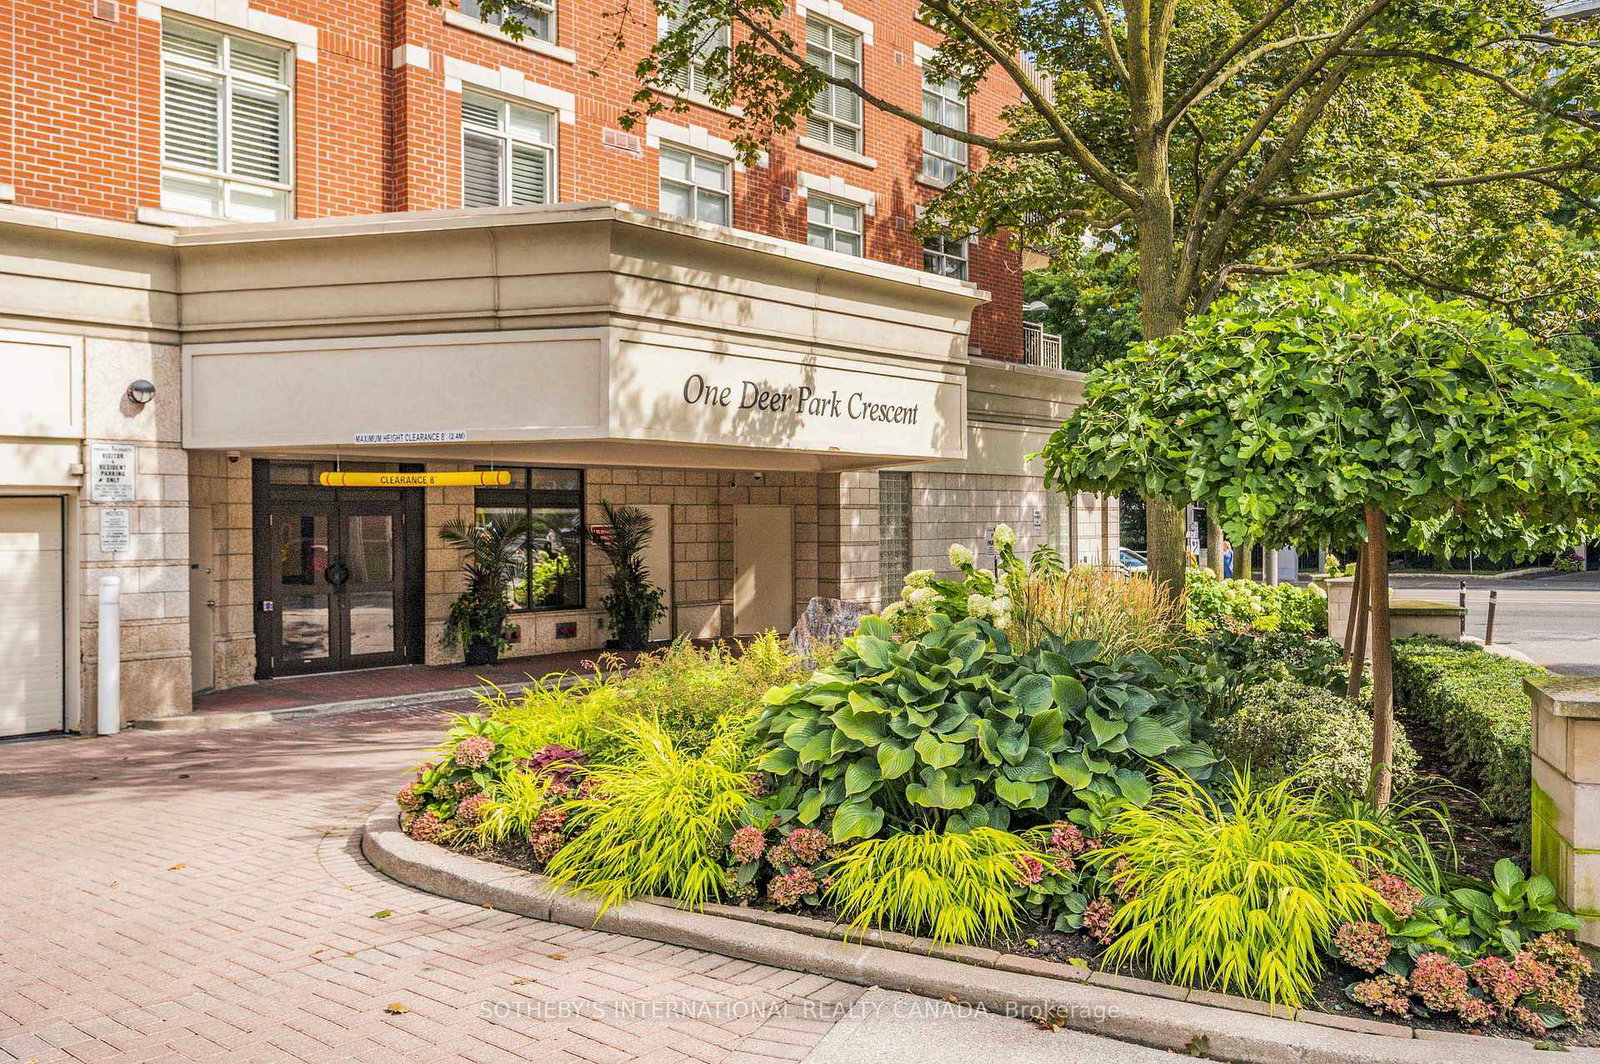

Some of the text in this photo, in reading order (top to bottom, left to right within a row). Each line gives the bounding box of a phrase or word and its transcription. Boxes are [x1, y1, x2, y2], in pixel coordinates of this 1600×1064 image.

[683, 374, 919, 425] One Deer Park Crescent
[355, 434, 382, 443] MAXIMUM
[383, 433, 403, 442] HEIGHT
[404, 432, 439, 442] CLEARANCE
[380, 475, 428, 485] CLEARANCE
